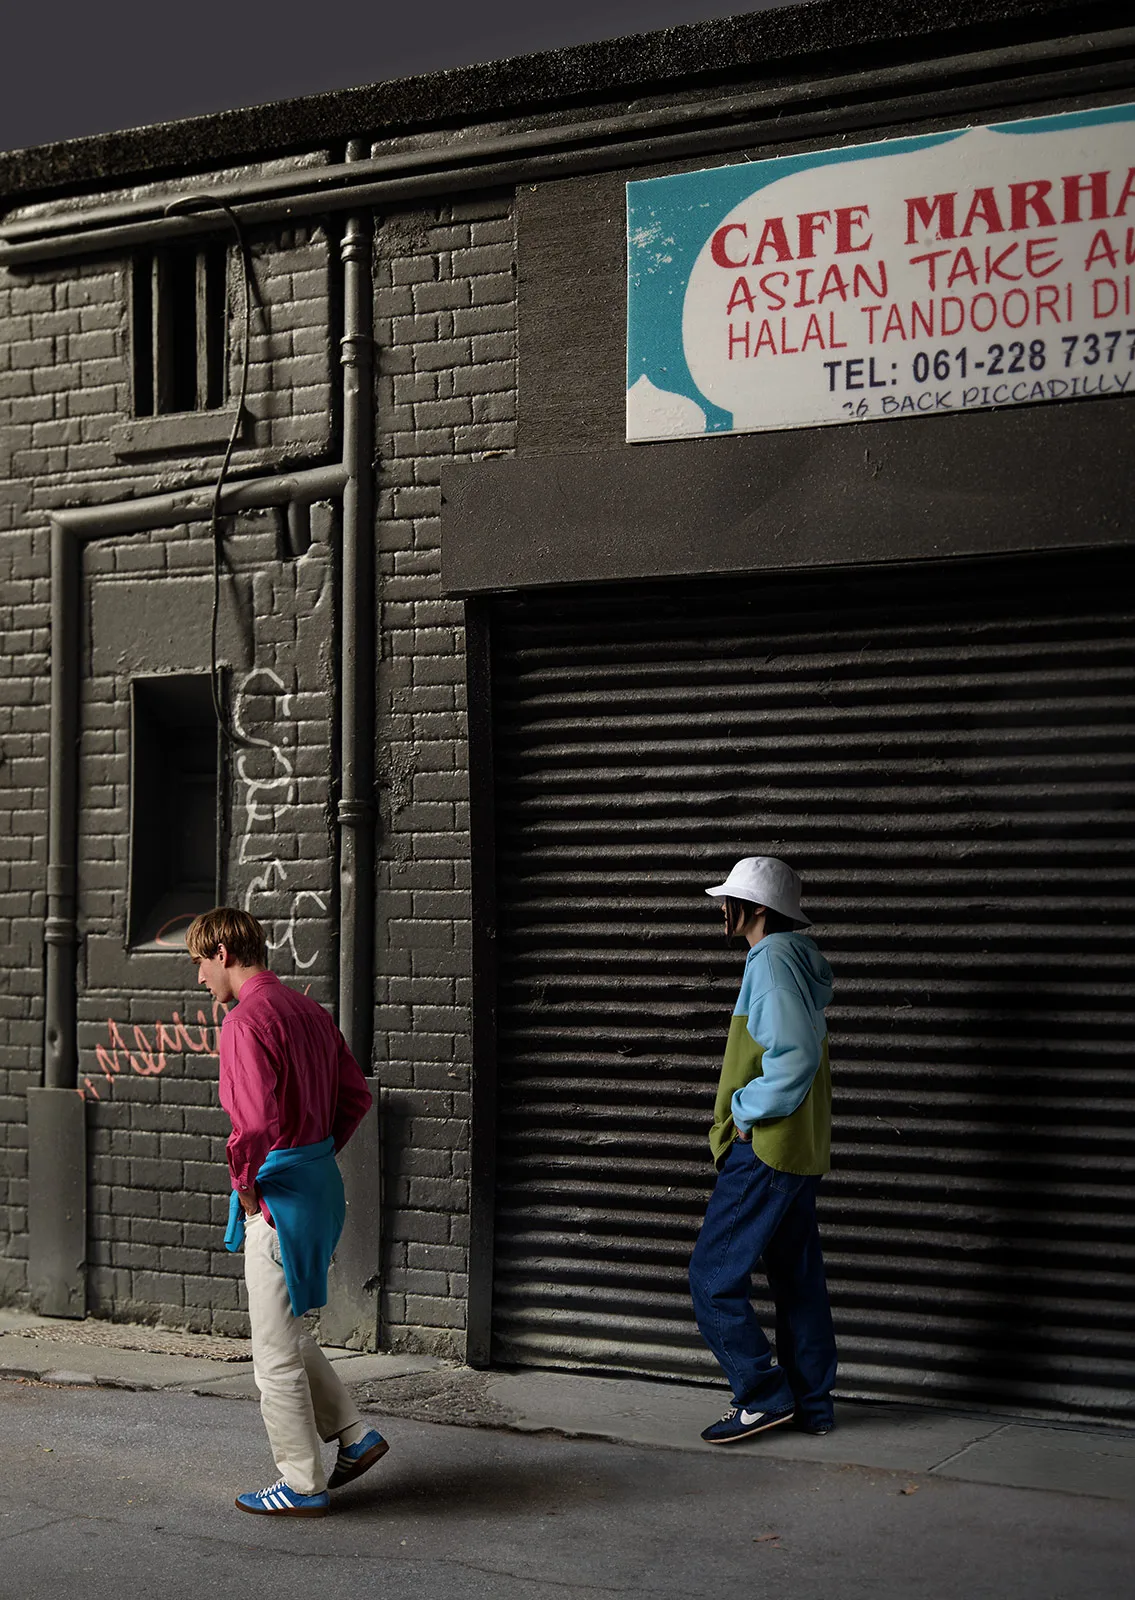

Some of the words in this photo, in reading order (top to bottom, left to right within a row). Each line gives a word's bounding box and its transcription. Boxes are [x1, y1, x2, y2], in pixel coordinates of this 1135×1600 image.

[710, 205, 873, 268] CAFE
[726, 260, 888, 316] ASIAN
[909, 237, 1063, 292] TAKE
[728, 312, 848, 360] HALAL
[860, 283, 1072, 345] TANDOORI
[1092, 276, 1131, 319] DI
[823, 357, 897, 392] TEL:
[912, 339, 1047, 383] 061-228
[880, 390, 953, 415] BACK
[962, 371, 1133, 408] PICCADILLY
